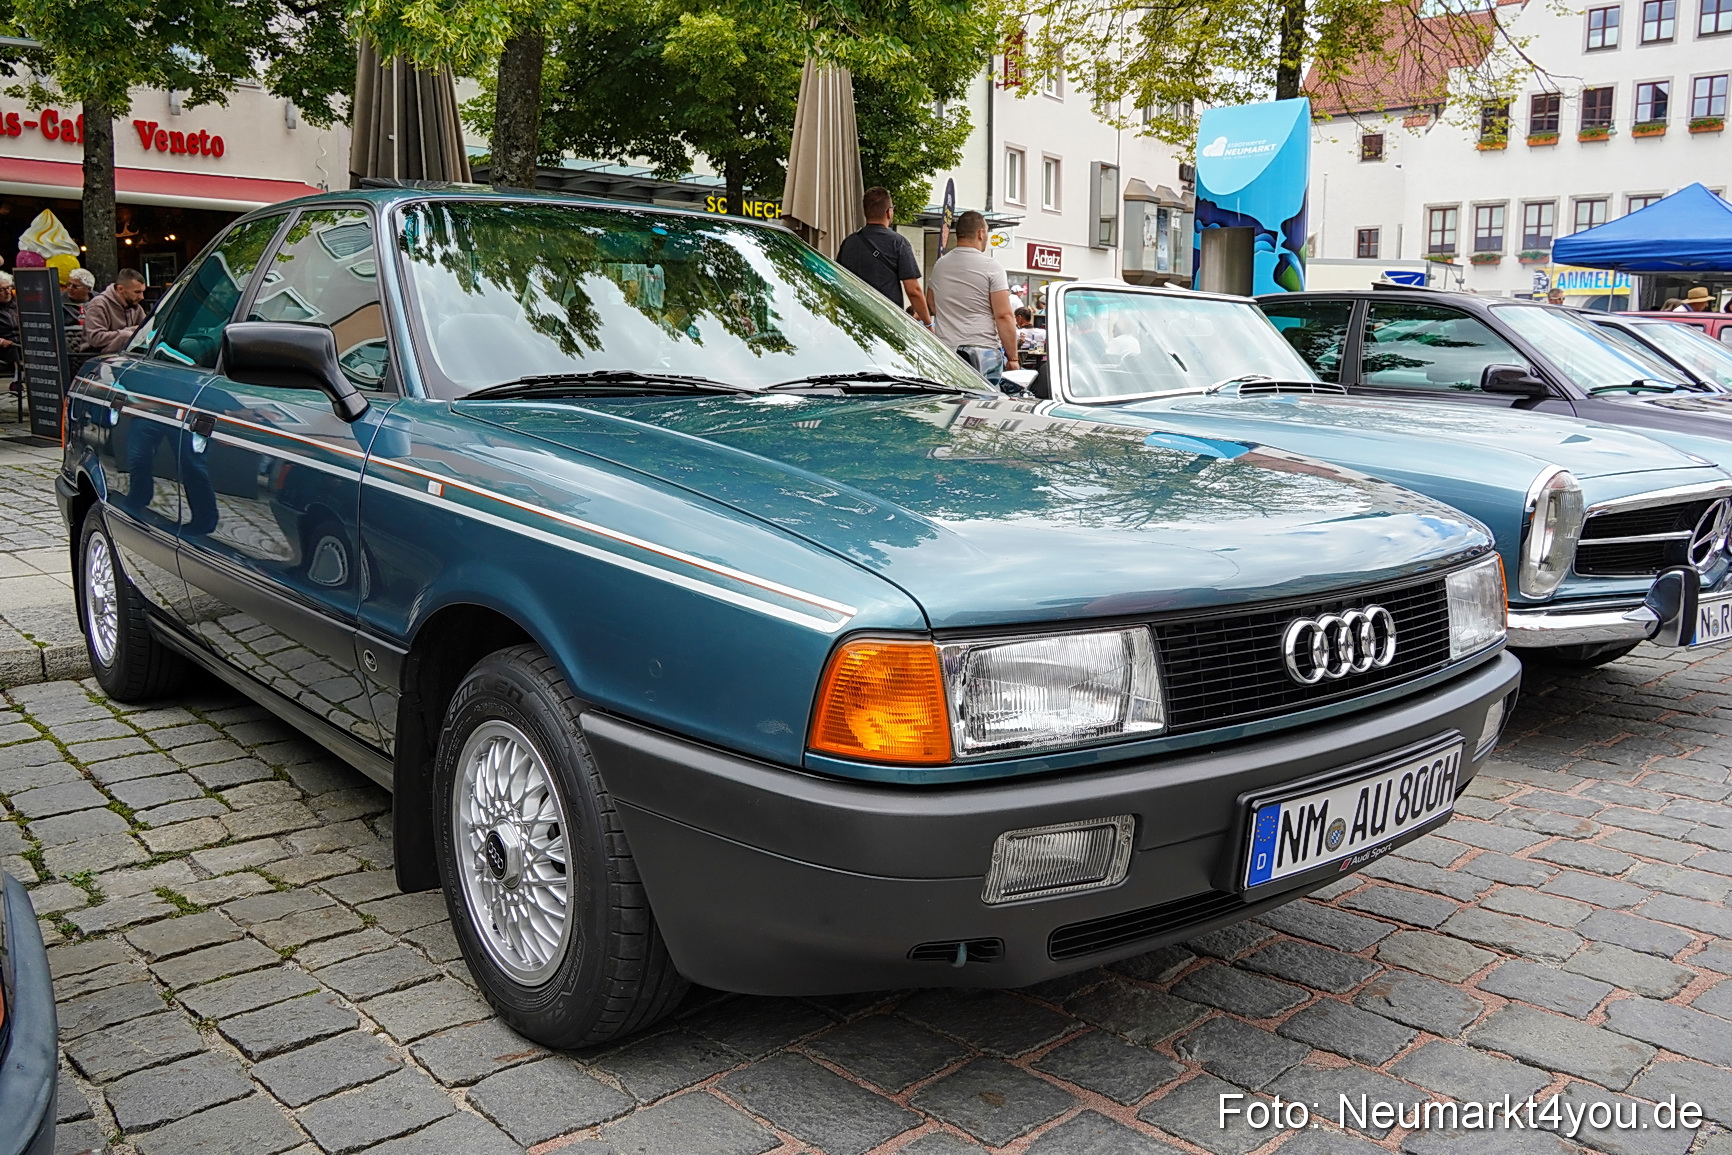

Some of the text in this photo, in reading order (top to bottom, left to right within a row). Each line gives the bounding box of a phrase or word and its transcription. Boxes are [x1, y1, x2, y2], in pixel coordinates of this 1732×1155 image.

[133, 120, 224, 157] Veneto
[1224, 144, 1277, 156] NEUMARKT
[1032, 246, 1062, 269] Achatz
[1701, 604, 1732, 638] N R
[1277, 752, 1459, 868] NM AU 800H
[1257, 853, 1267, 870] D
[1350, 843, 1393, 866] Audi Sport
